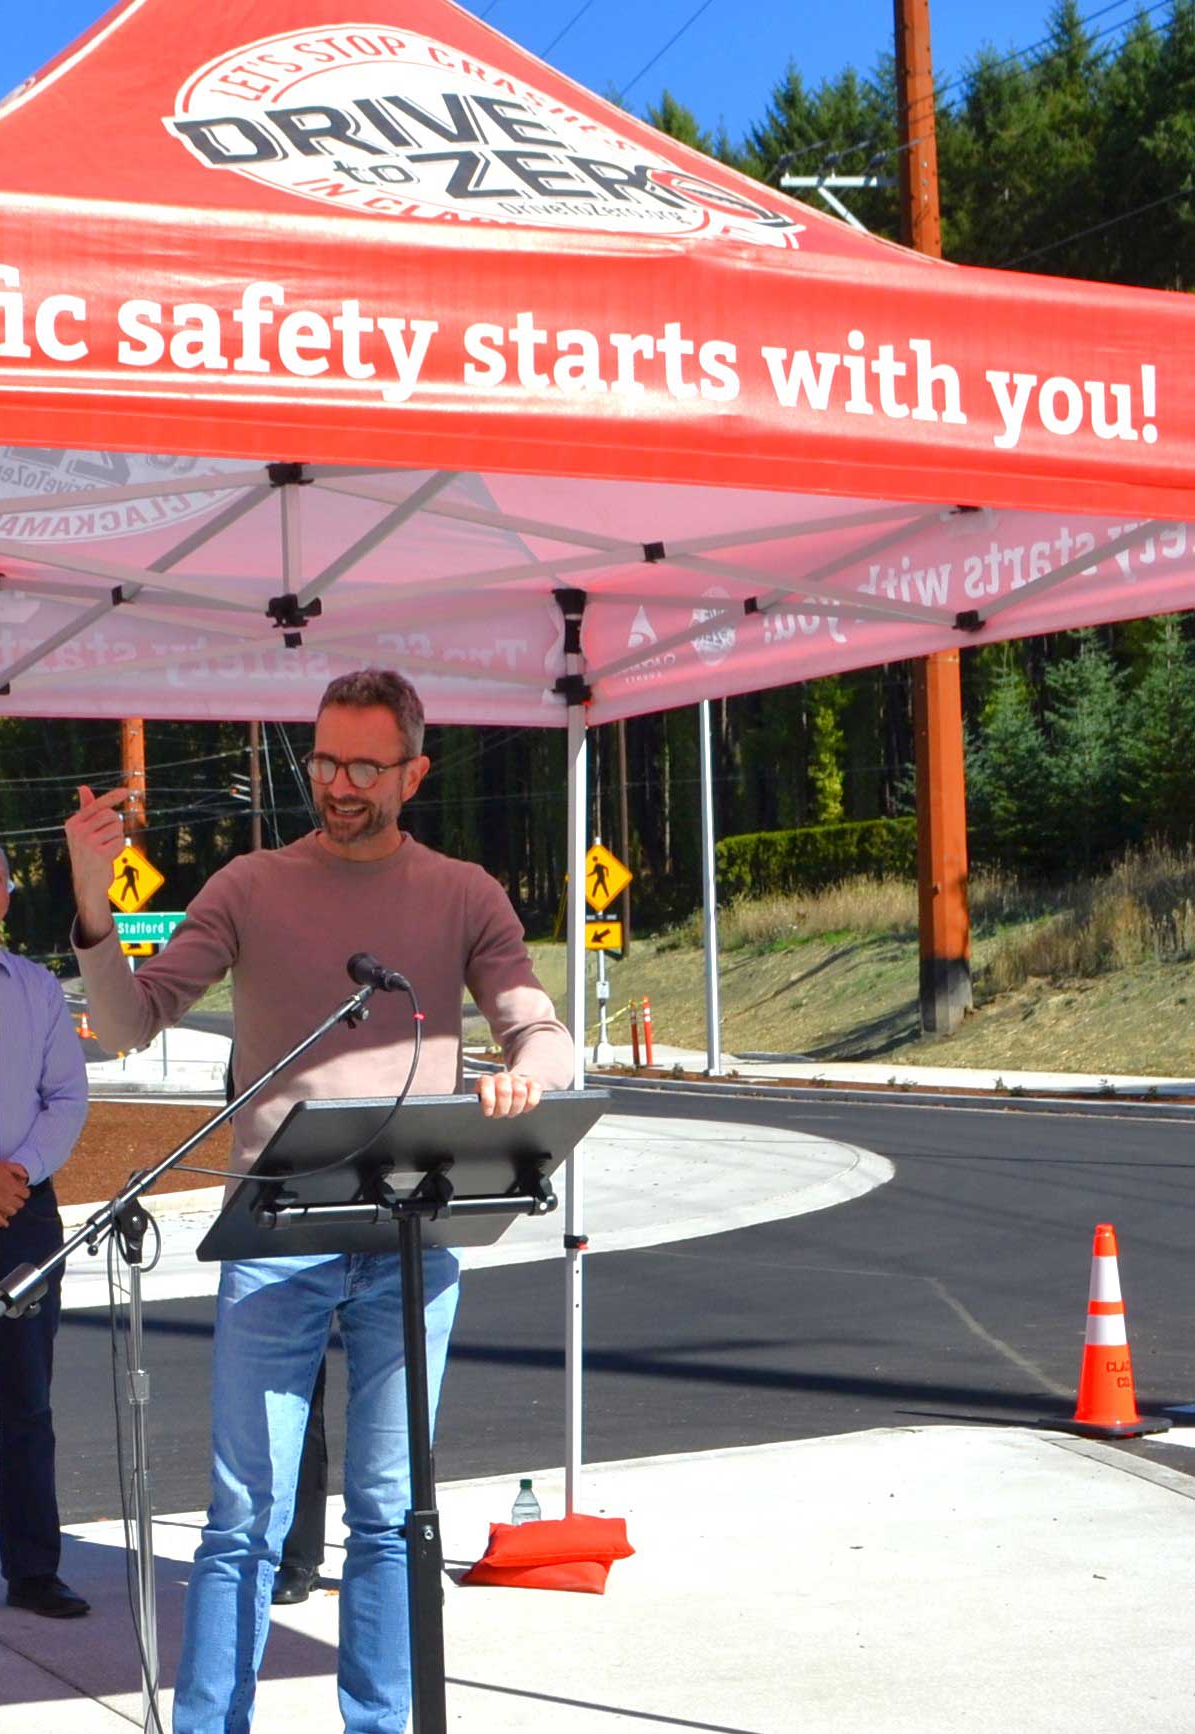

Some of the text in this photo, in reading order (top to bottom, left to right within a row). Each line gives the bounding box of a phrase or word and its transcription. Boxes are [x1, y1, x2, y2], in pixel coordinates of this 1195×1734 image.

[210, 54, 303, 101] LET'S
[293, 34, 407, 62] STOP
[173, 92, 574, 165] DRIVE
[292, 177, 360, 198] IN
[333, 150, 797, 228] to ZERO
[117, 281, 438, 402] safety
[464, 312, 741, 400] starts
[762, 330, 967, 425] with
[986, 364, 1158, 449] you!
[117, 921, 164, 934] Stafford
